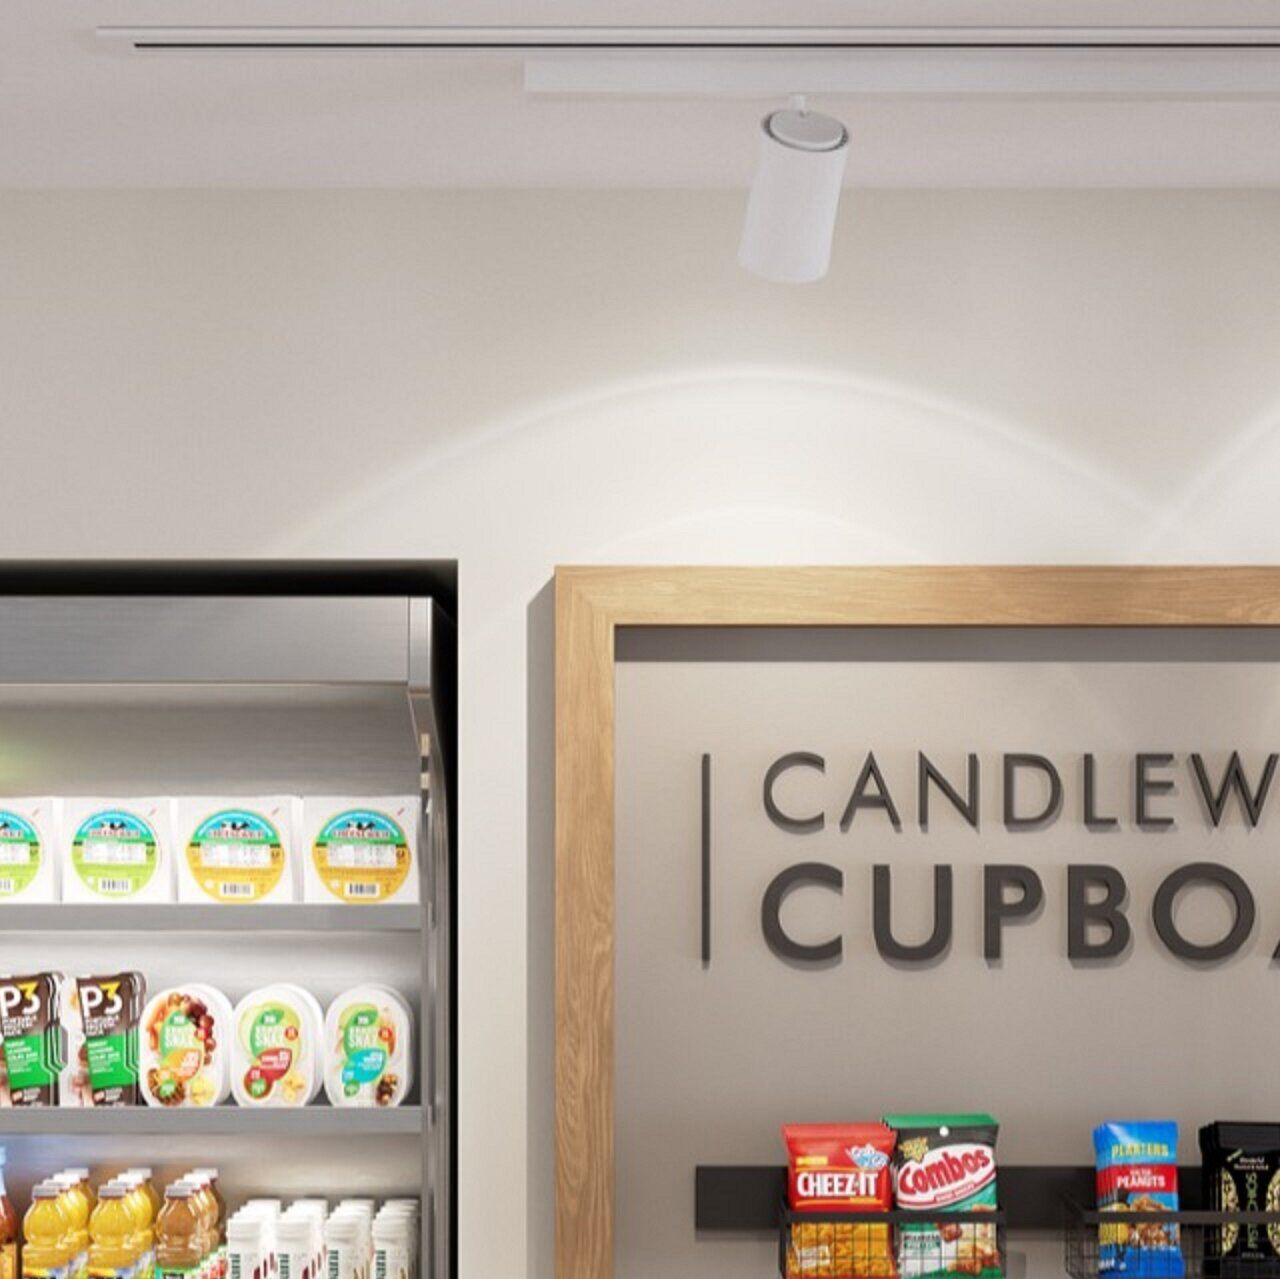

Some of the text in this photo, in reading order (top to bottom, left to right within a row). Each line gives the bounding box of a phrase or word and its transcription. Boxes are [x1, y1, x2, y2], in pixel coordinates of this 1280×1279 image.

[80, 981, 123, 1018] P3
[1111, 1143, 1169, 1157] PLANTERS
[797, 1171, 879, 1197] CHEEZ-IT
[900, 1149, 990, 1194] Combos
[1116, 1175, 1166, 1189] PEANUTS
